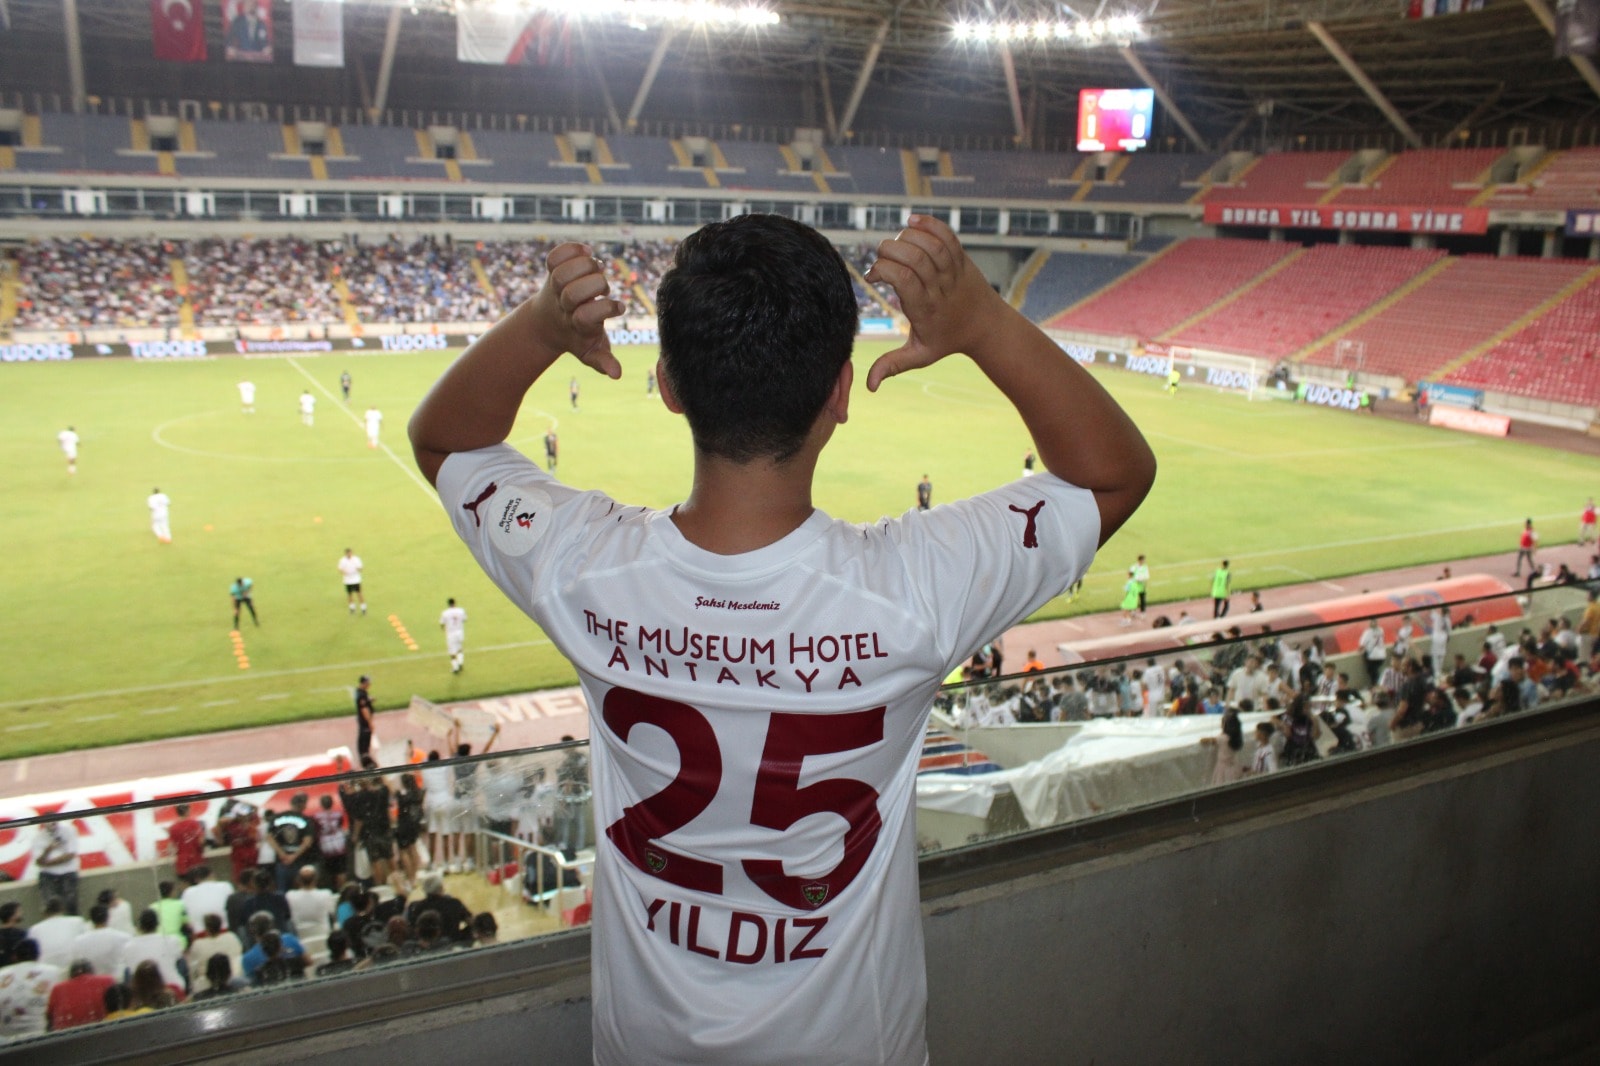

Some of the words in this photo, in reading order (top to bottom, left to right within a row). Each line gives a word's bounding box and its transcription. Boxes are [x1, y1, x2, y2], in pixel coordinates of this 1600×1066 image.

[1290, 209, 1322, 227] YIL
[1332, 211, 1398, 229] SONRA
[1411, 209, 1463, 231] YİNE
[130, 340, 208, 358] TUDORS
[379, 333, 448, 351] TUDORS
[608, 329, 661, 345] UDORS
[0, 343, 74, 362] UDORS
[504, 498, 522, 534] trendyol
[695, 596, 726, 609] Şahsi
[728, 600, 781, 611] Meselemiz
[583, 609, 628, 646] THE
[638, 626, 775, 665] MUSEUM
[789, 631, 889, 664] HOTEL
[608, 645, 862, 693] ANTAKYA
[479, 686, 588, 723] ME
[602, 685, 888, 912] 25
[646, 898, 829, 965] YILDIZ
